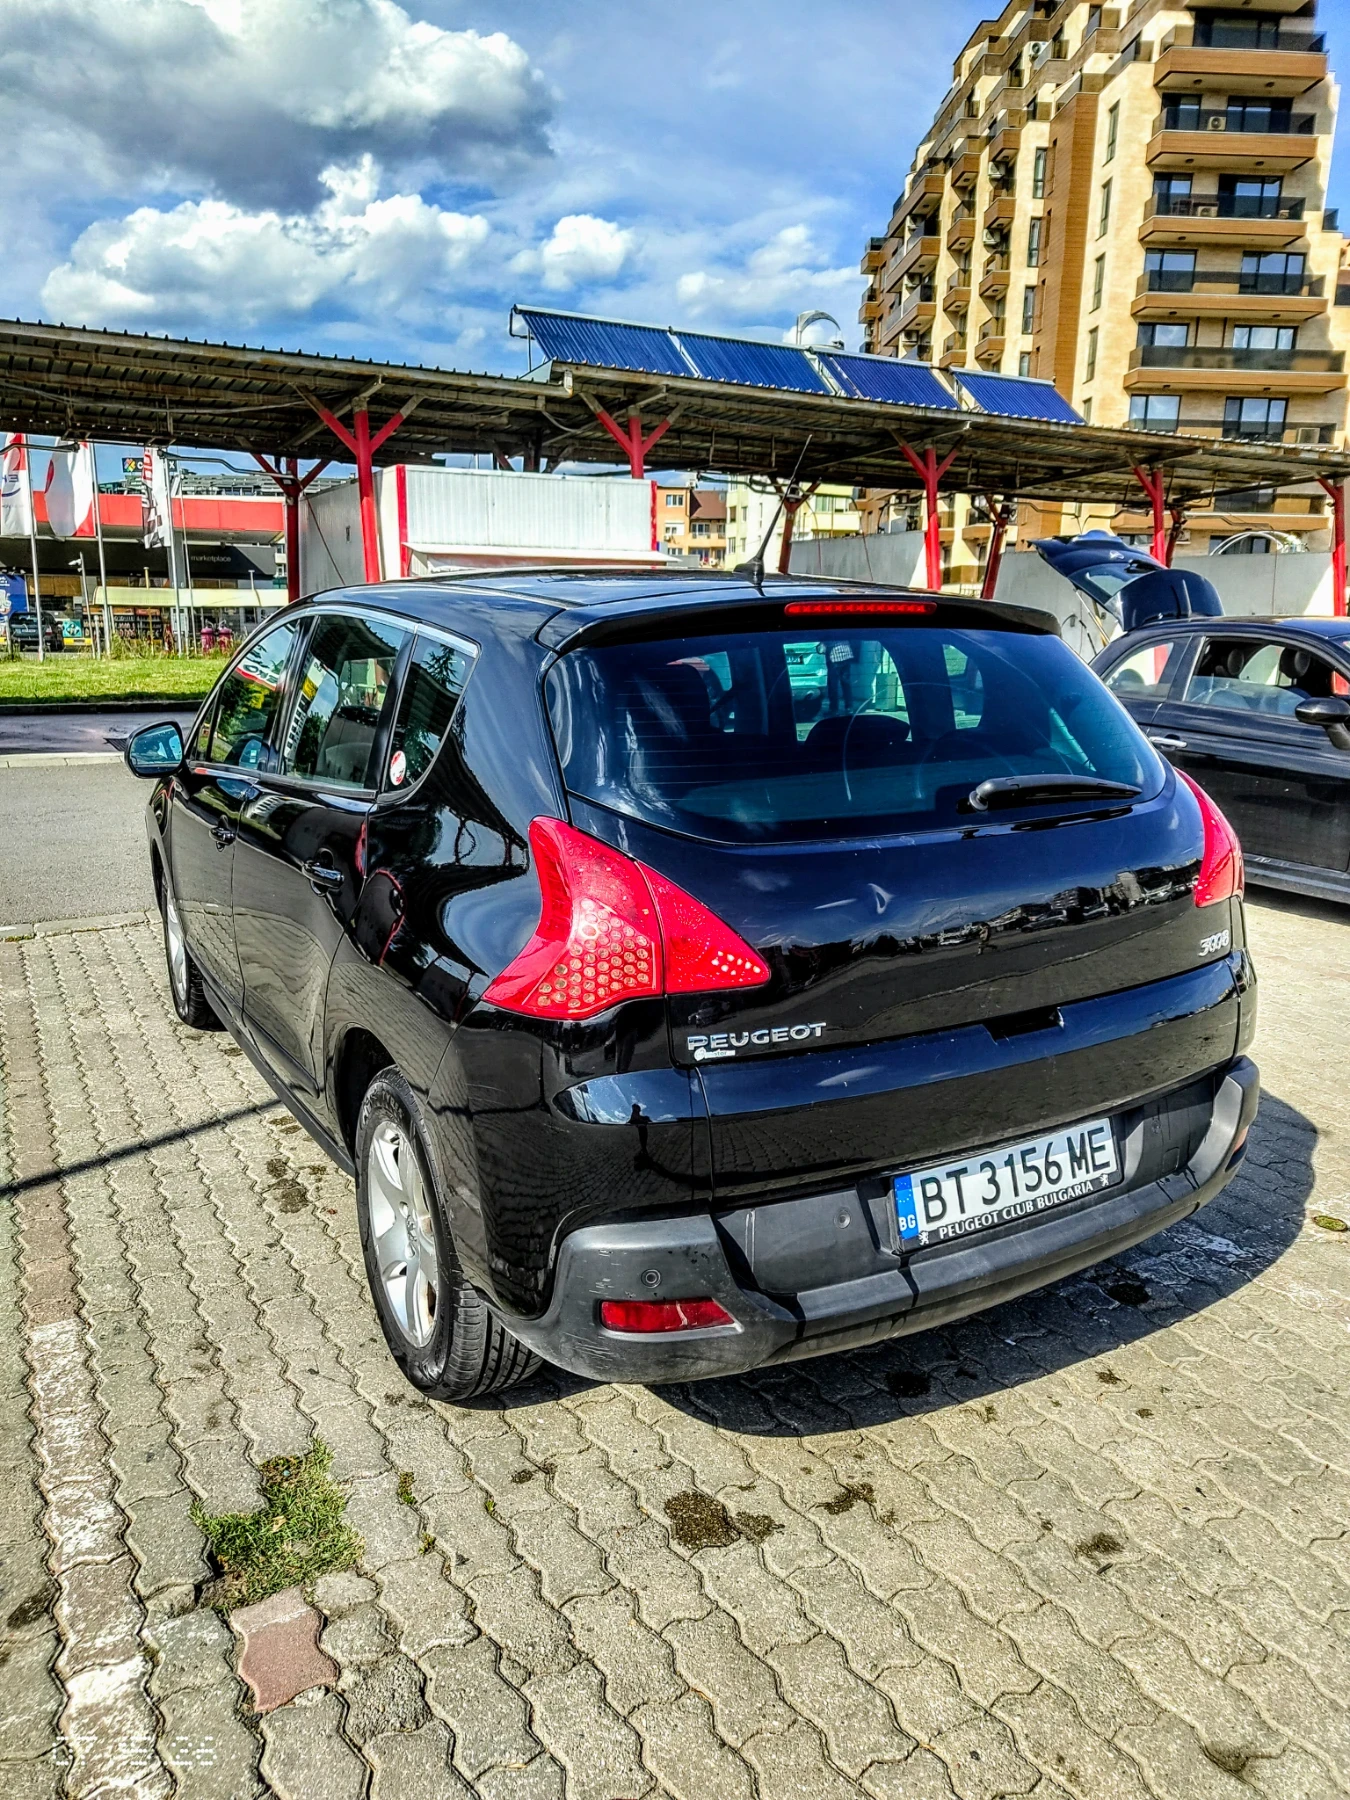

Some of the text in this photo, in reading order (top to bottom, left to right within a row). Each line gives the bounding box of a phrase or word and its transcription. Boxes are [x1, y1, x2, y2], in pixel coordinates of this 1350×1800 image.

[190, 555, 232, 563] marketplace
[1198, 929, 1230, 957] 3008
[687, 1022, 827, 1051] PEUGEOT
[920, 1126, 1111, 1224] BT 3156 ME
[898, 1214, 917, 1232] BG
[939, 1181, 1094, 1240] PEUGEOT CLUB BULGARIA
